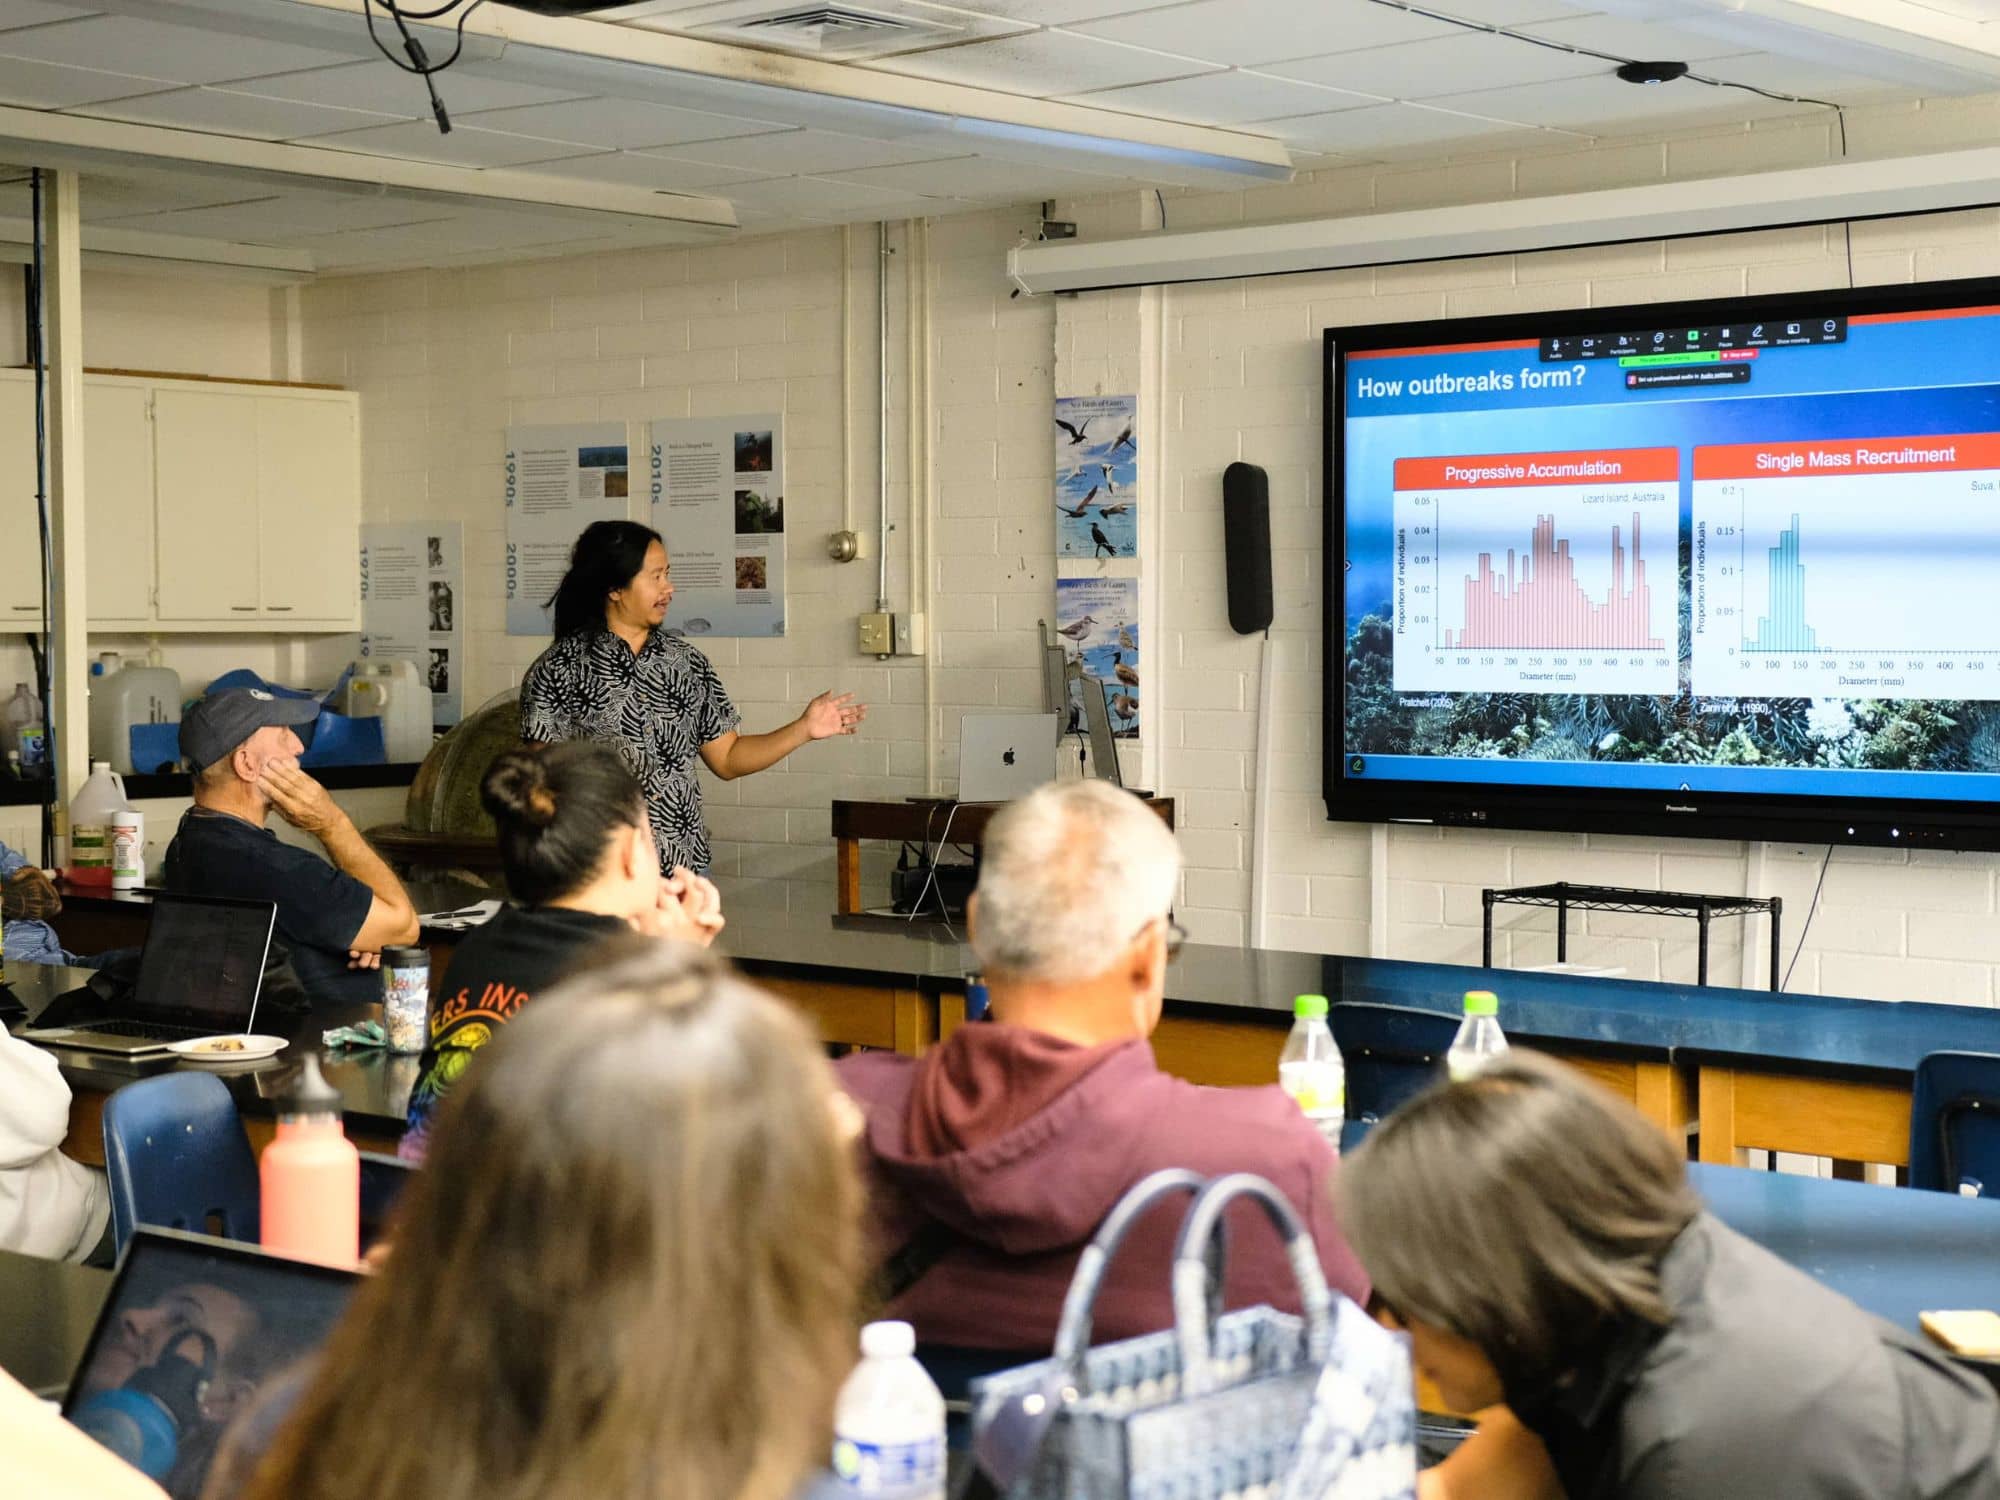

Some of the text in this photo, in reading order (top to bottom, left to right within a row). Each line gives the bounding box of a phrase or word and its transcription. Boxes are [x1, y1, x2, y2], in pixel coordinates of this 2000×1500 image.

[1358, 365, 1586, 398] How outbreaks form?
[1445, 461, 1622, 484] Progressive Accumulation
[1756, 446, 1956, 472] Single Mass Recruitment
[506, 451, 516, 507] 1990s
[651, 445, 662, 504] 2010s
[1582, 494, 1604, 504] Lizard
[1632, 492, 1665, 502] Australia
[1716, 526, 1734, 536] 0.15
[1397, 528, 1406, 576] individuals
[1696, 521, 1706, 572] individuals
[506, 544, 516, 600] 2000s
[1397, 588, 1406, 634] Proportion
[1696, 584, 1706, 634] Proportion
[1434, 658, 1670, 666] 50 100 150 200 250 300 350 400 450 500
[1740, 660, 1984, 670] 50 100 150 200 250 300 350 400 450
[1520, 672, 1577, 682] Diameter (mm)
[1838, 676, 1904, 687] Diameter (mm)
